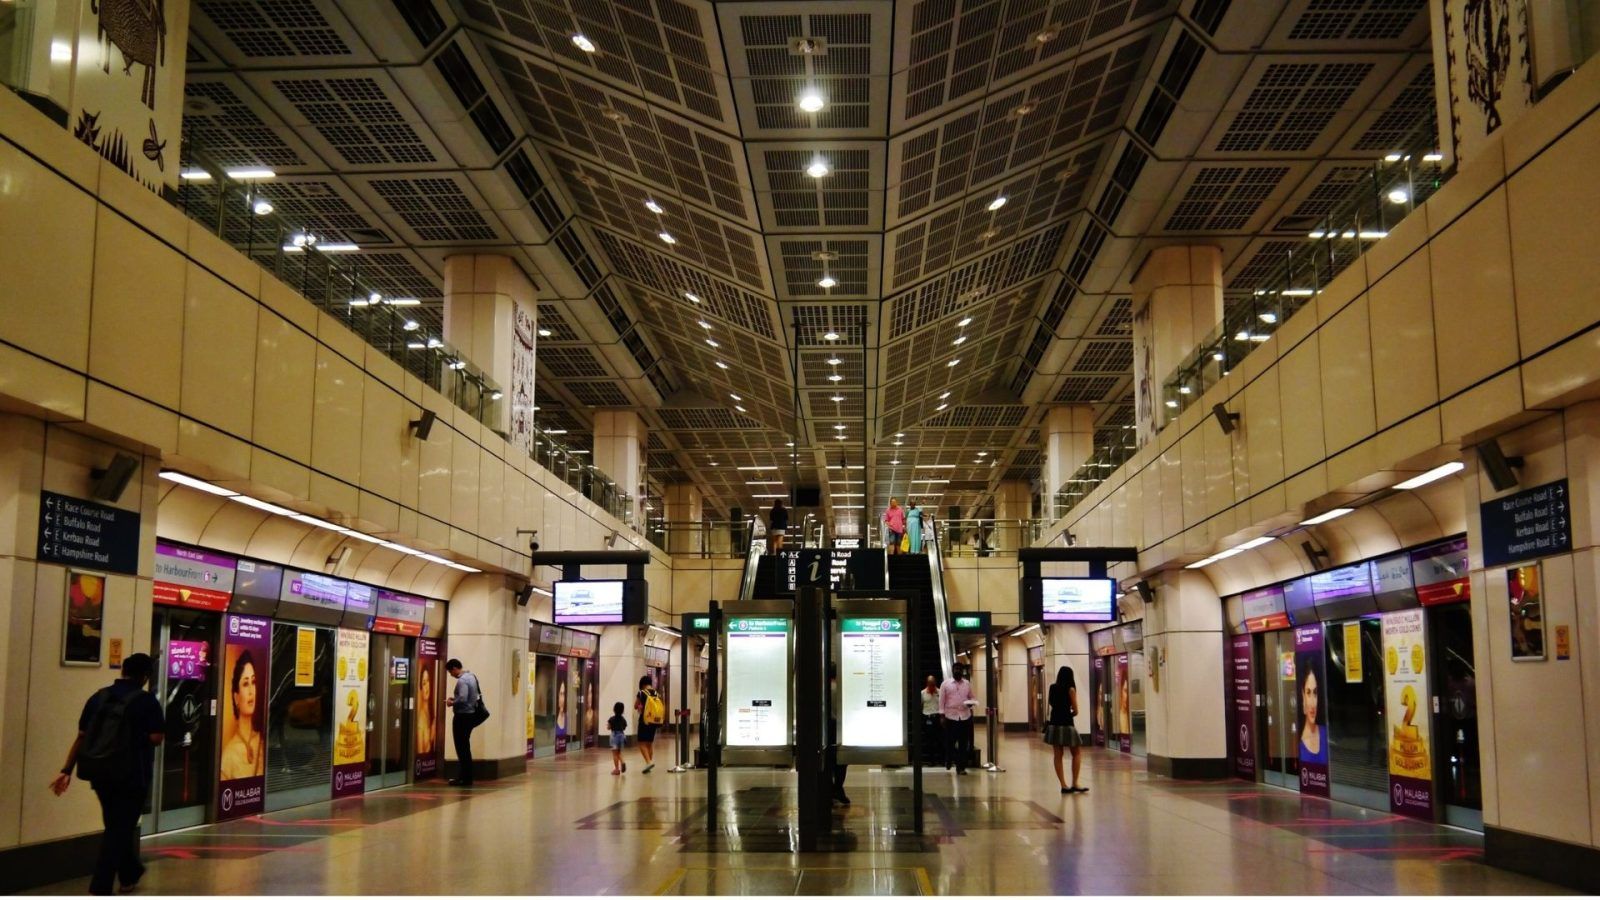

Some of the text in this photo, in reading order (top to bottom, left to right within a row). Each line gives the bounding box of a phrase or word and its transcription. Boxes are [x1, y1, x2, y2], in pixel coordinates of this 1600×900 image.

[1503, 501, 1514, 511] Race
[1533, 490, 1548, 502] Road
[64, 501, 79, 512] Race
[80, 505, 100, 518] Course
[100, 510, 115, 521] Road
[1515, 510, 1534, 523] Buffalo
[1534, 507, 1548, 518] Road
[63, 516, 85, 529] Buffalo
[86, 522, 102, 532] Road
[1535, 520, 1549, 532] Road
[62, 530, 84, 544] Kerbau
[85, 534, 100, 547] Road
[1508, 542, 1536, 554] Hampshire
[1536, 535, 1550, 548] Road
[62, 546, 94, 560] Hampshire
[94, 551, 110, 563] Road
[344, 771, 363, 781] MALABAR
[235, 786, 261, 799] MALABAR
[1404, 789, 1430, 800] MALABAR
